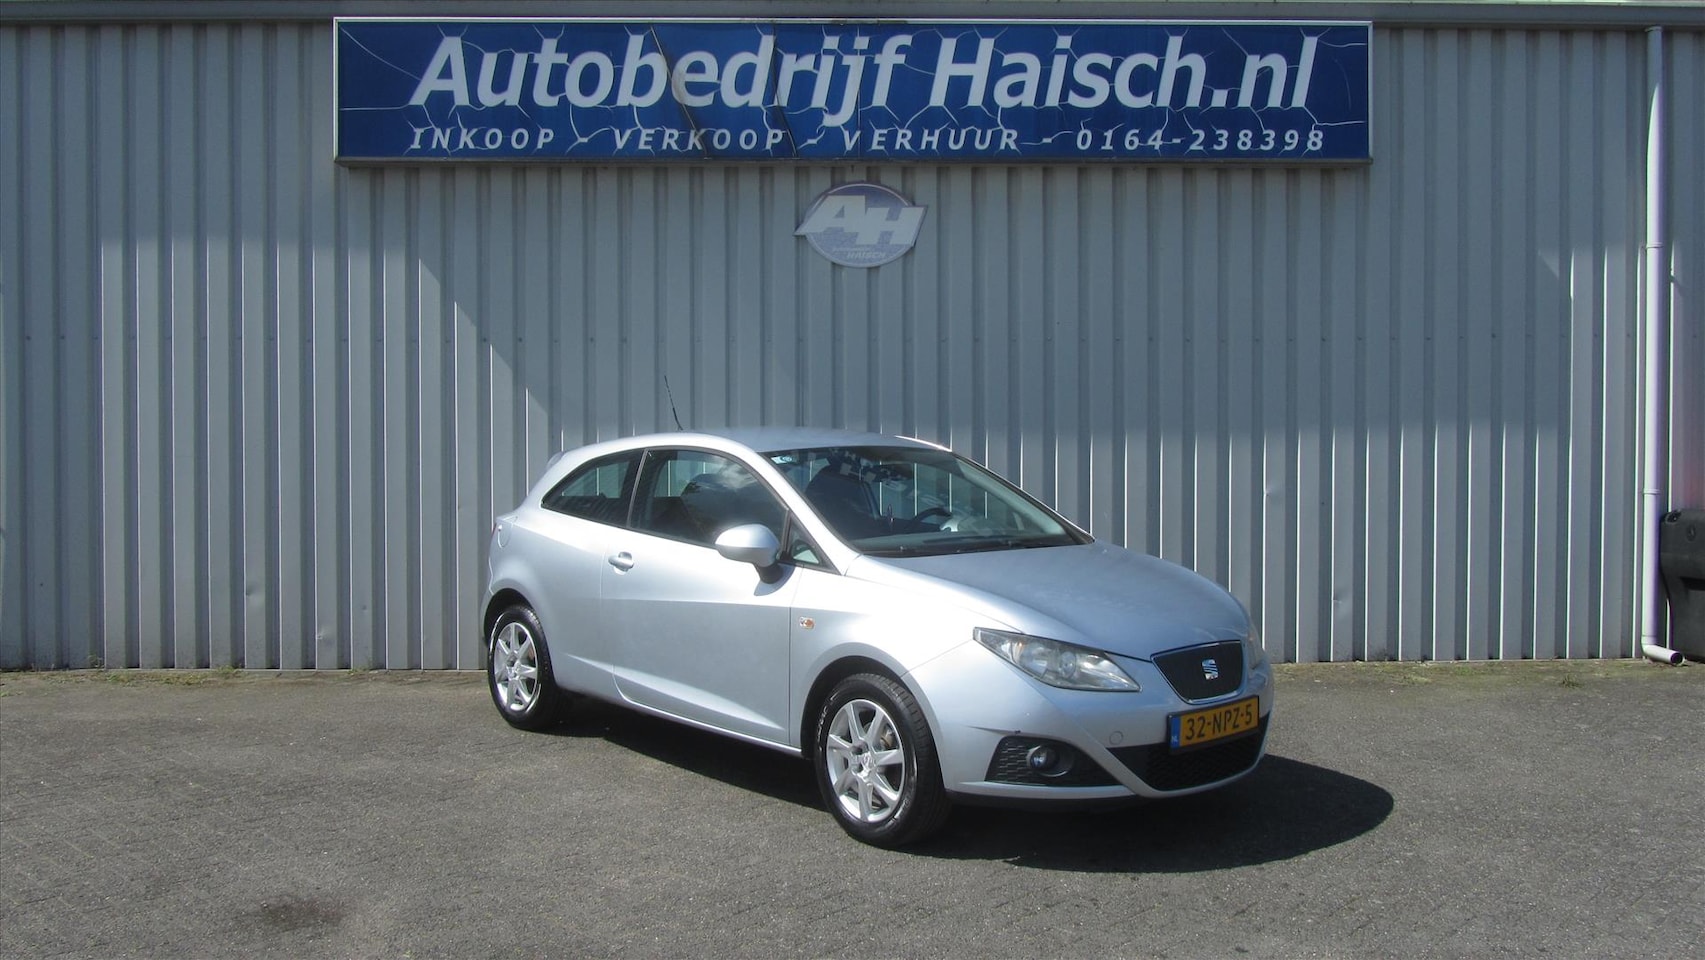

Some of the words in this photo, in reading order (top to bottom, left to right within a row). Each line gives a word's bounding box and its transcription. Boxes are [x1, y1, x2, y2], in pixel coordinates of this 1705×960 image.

[408, 35, 912, 127] Autobedrijf
[929, 35, 1318, 108] Haisch.nl
[409, 128, 554, 149] INKOOP
[614, 128, 783, 150] VERKOOP
[844, 128, 1018, 150] VERHUUR
[1076, 129, 1324, 151] 0164-238398
[794, 195, 925, 245] AH
[1185, 704, 1253, 741] 32-NPZ-5
